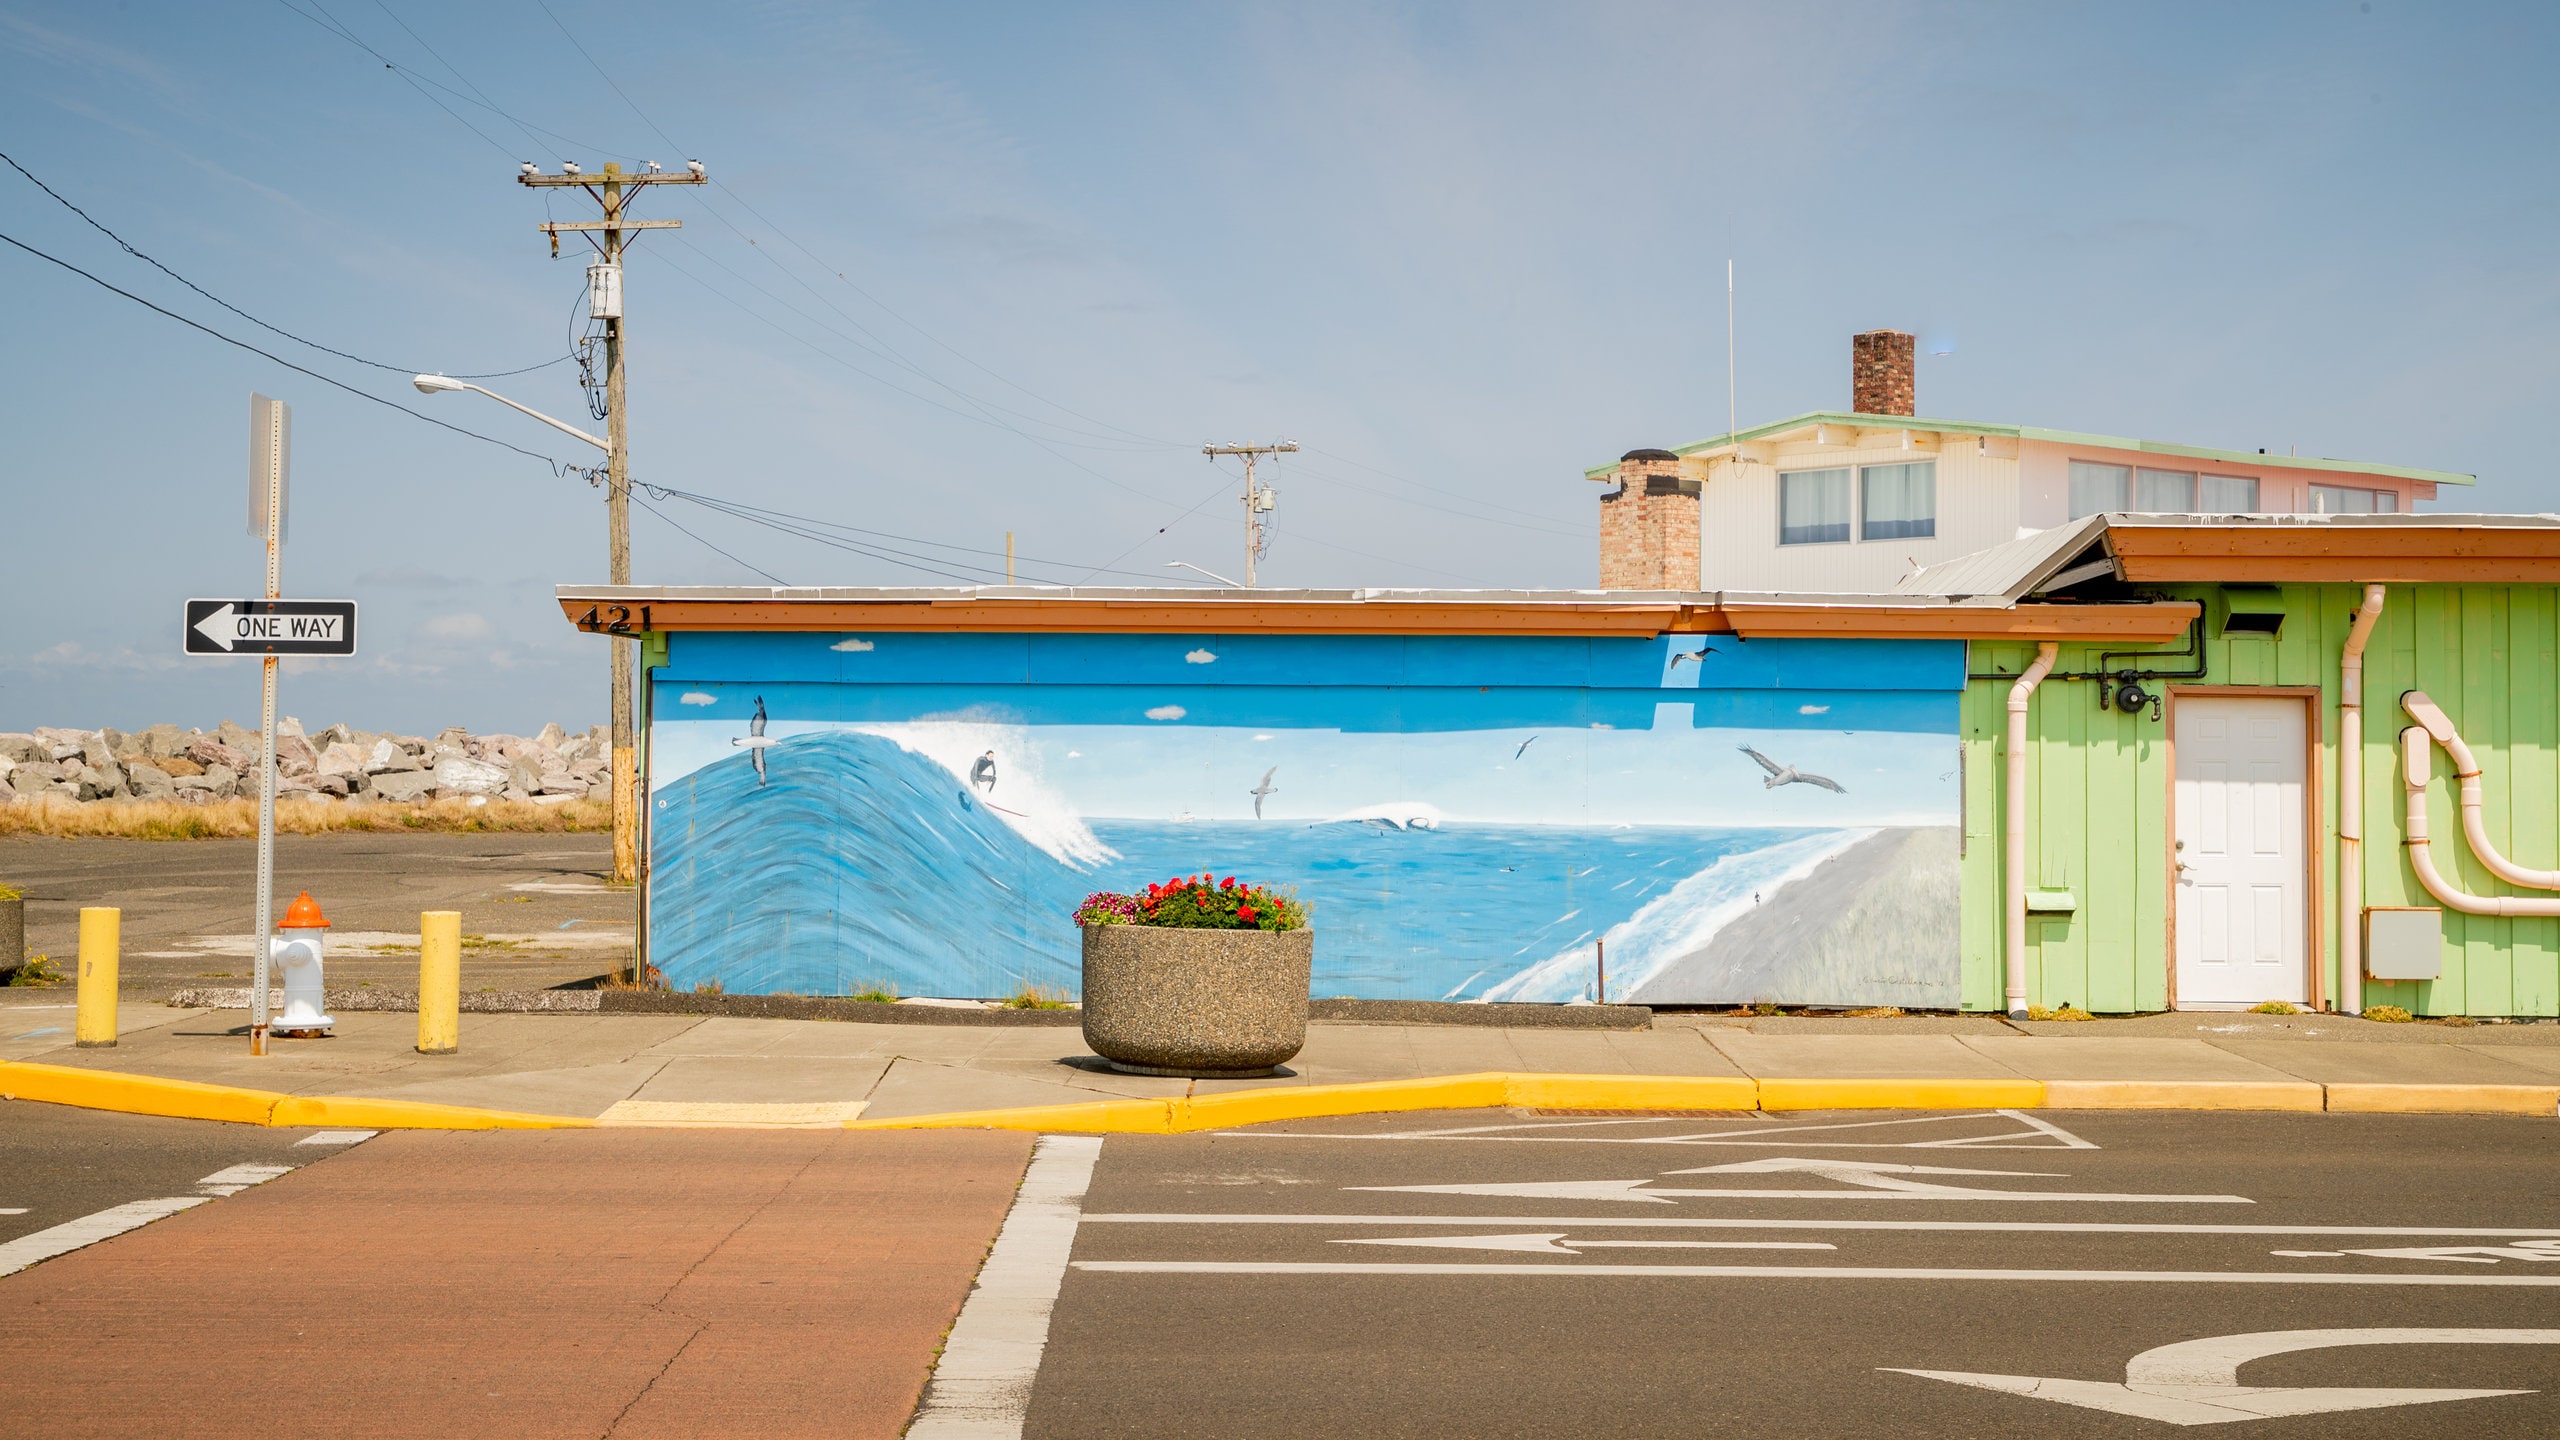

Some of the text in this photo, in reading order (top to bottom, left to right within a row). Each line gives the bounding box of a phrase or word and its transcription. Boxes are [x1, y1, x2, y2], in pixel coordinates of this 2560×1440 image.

[237, 617, 336, 638] ONE WAY
[579, 604, 653, 633] 421
